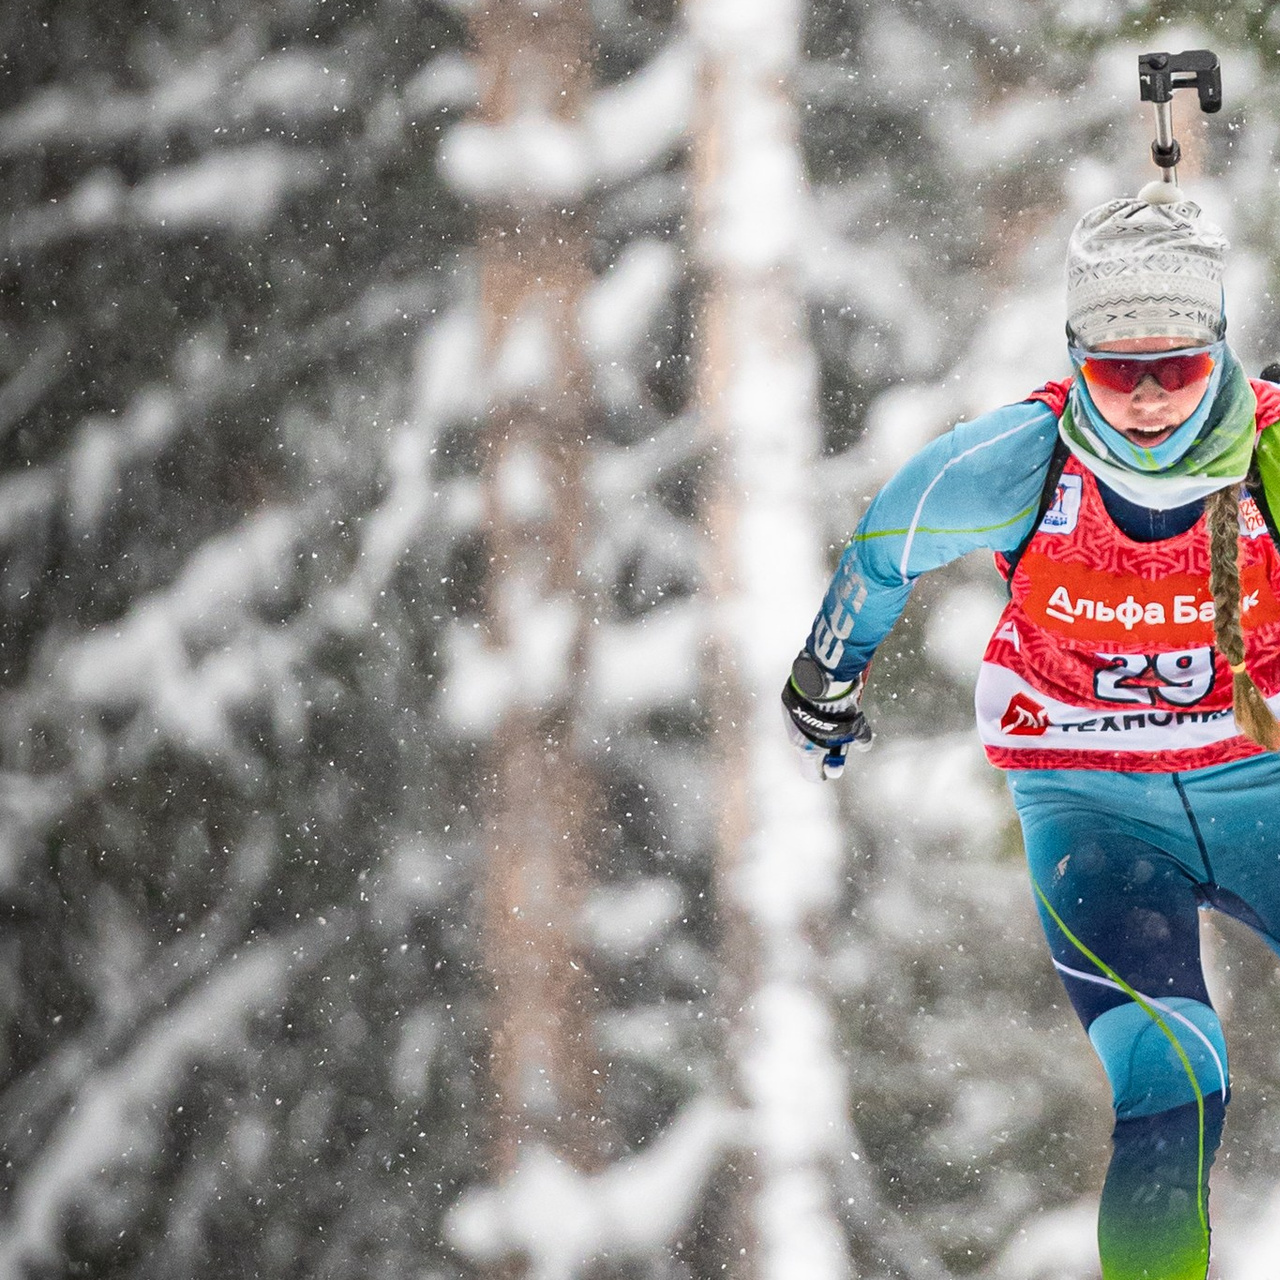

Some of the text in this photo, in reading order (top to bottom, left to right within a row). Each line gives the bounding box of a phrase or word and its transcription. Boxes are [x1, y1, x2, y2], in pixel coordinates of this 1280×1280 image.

[1046, 586, 1259, 630] Альфа Бак
[1093, 646, 1215, 707] 29
